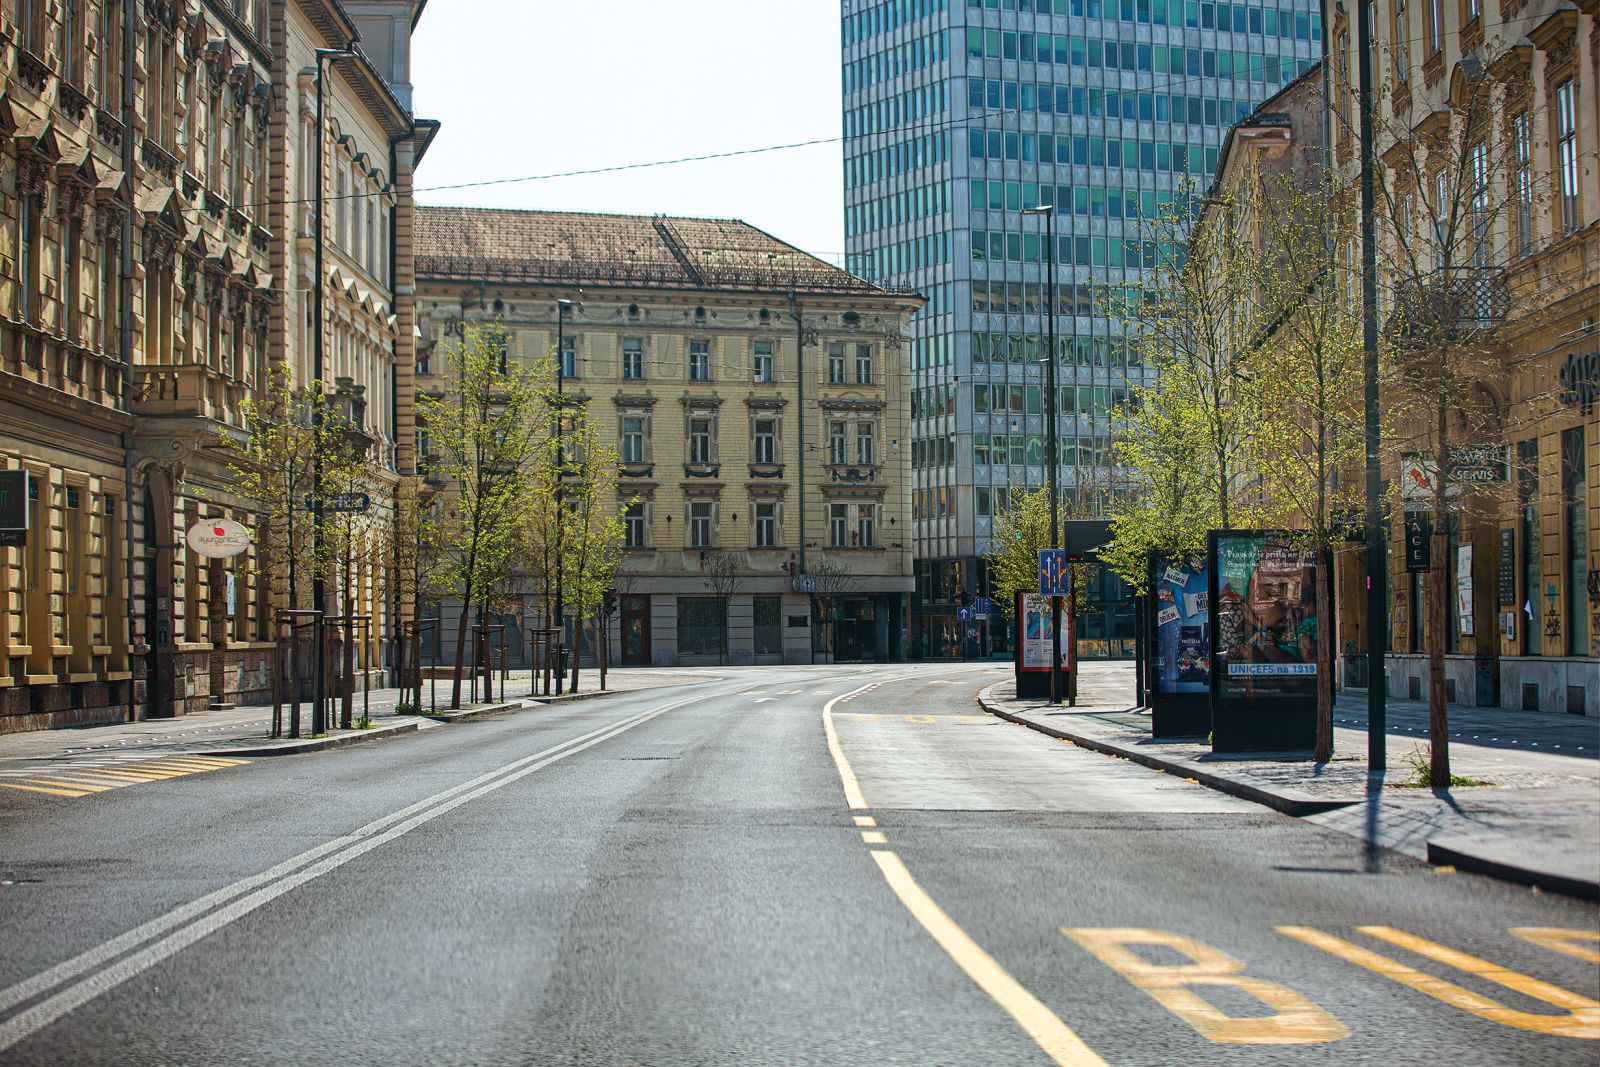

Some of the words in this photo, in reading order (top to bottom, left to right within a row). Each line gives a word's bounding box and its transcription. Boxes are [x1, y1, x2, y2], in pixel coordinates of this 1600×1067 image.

[1456, 470, 1494, 480] SERVIS
[1230, 664, 1274, 674] UNICEF5
[1277, 665, 1289, 674] na
[1293, 664, 1315, 674] 1919
